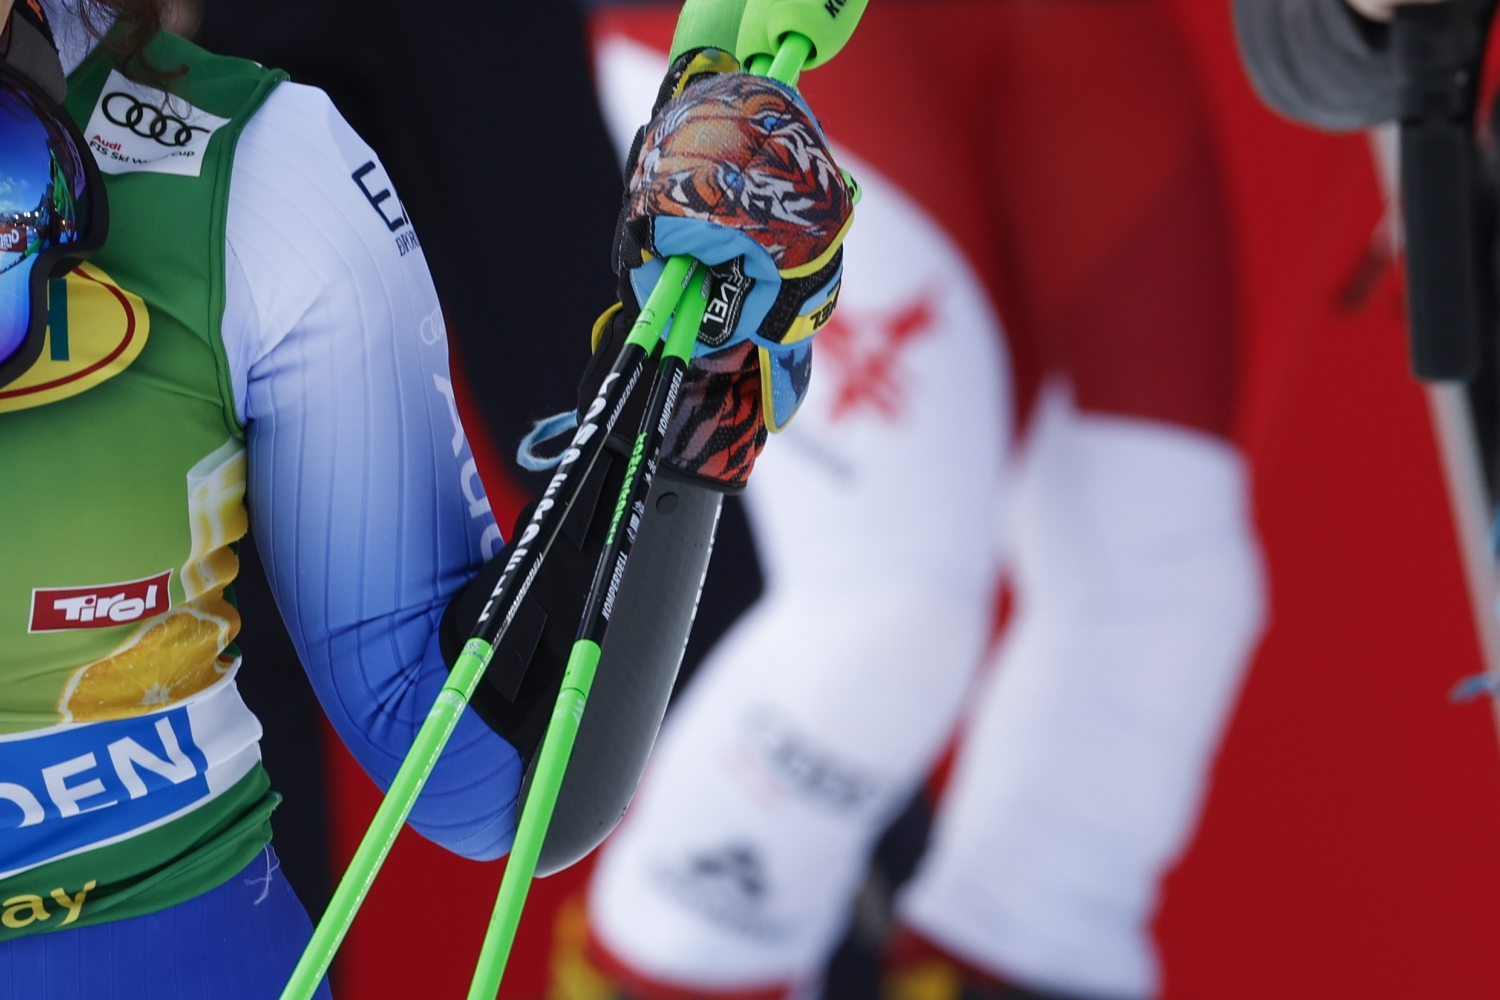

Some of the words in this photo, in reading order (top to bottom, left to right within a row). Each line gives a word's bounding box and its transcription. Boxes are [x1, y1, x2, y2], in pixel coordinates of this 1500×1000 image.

[89, 140, 109, 156] FIS
[110, 150, 130, 164] Ski
[92, 134, 122, 151] Audi
[657, 366, 684, 438] KOMPERDELL
[53, 585, 158, 622] Tirol
[601, 550, 629, 622] KOMPERDELL
